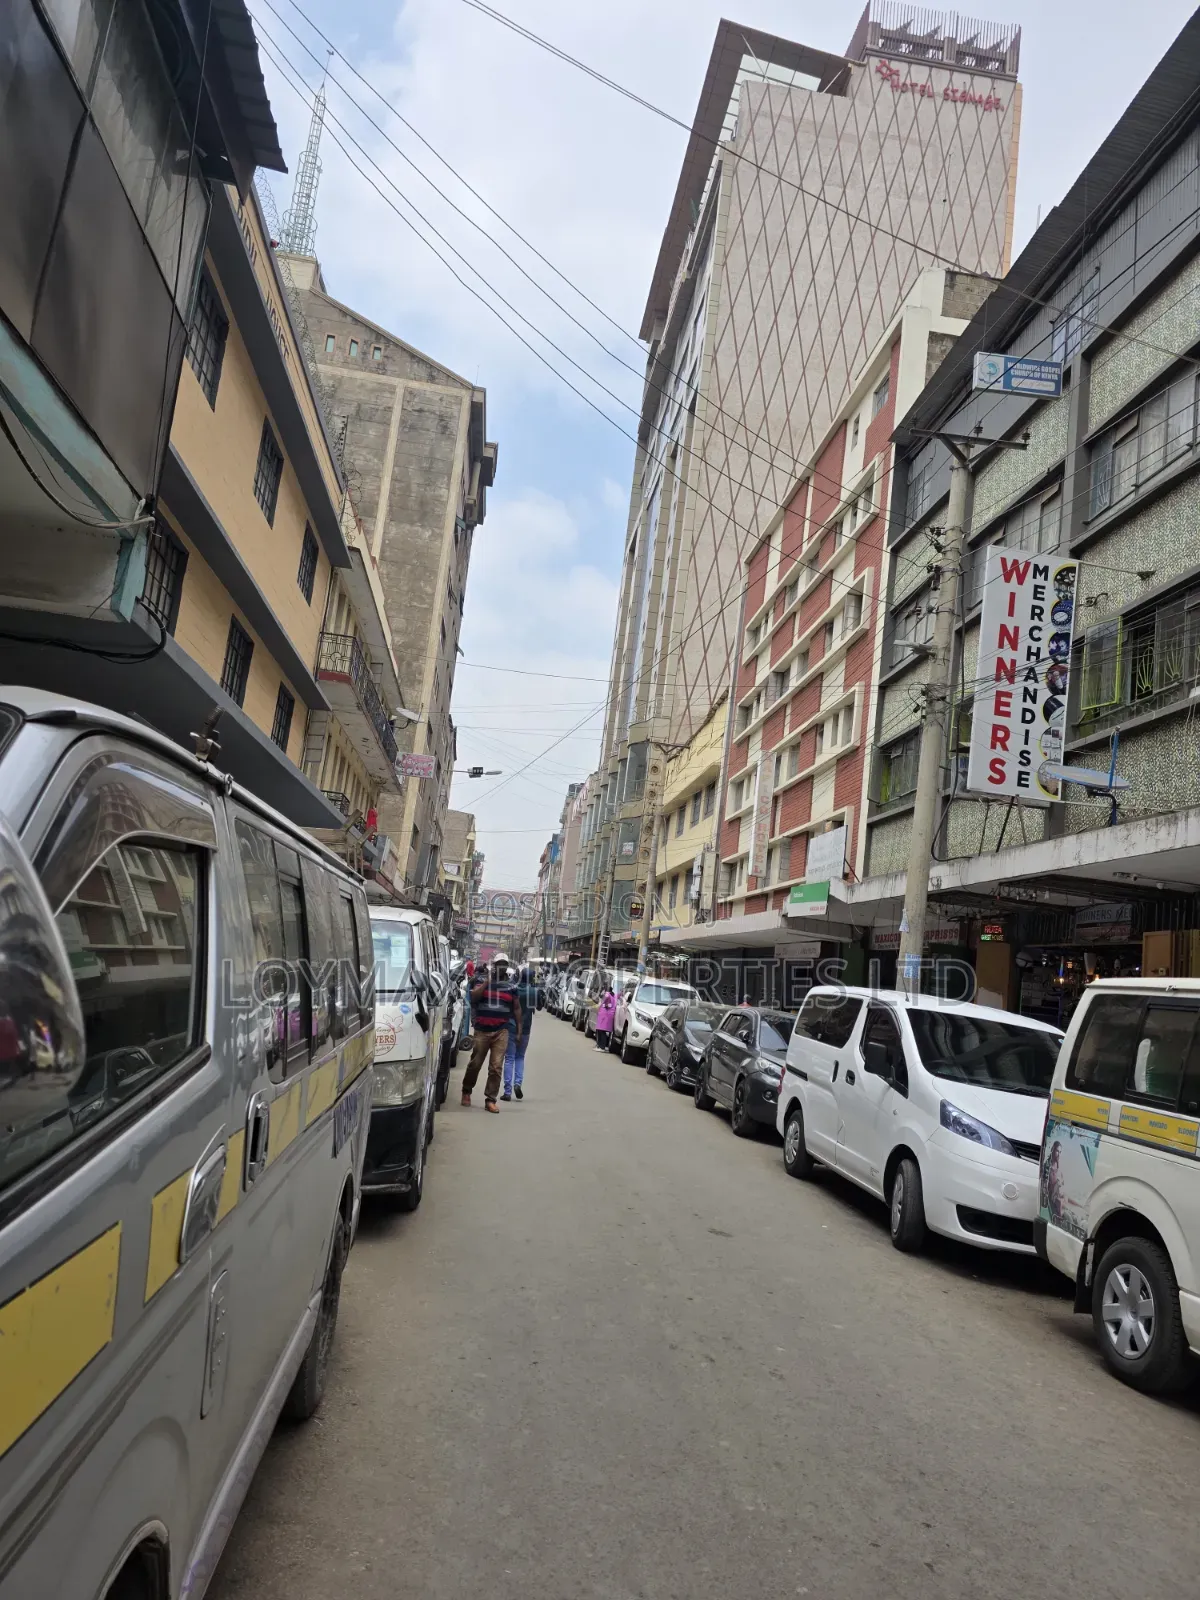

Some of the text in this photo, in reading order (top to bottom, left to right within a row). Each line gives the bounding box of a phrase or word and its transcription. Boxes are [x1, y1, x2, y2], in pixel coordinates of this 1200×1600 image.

[890, 77, 934, 98] HOTEL
[1008, 362, 1061, 374] WORLDWIDE GOSPEL
[1011, 369, 1034, 377] CHURCH
[987, 556, 1031, 785] WINNERS
[1017, 563, 1050, 788] MERCHANDISE
